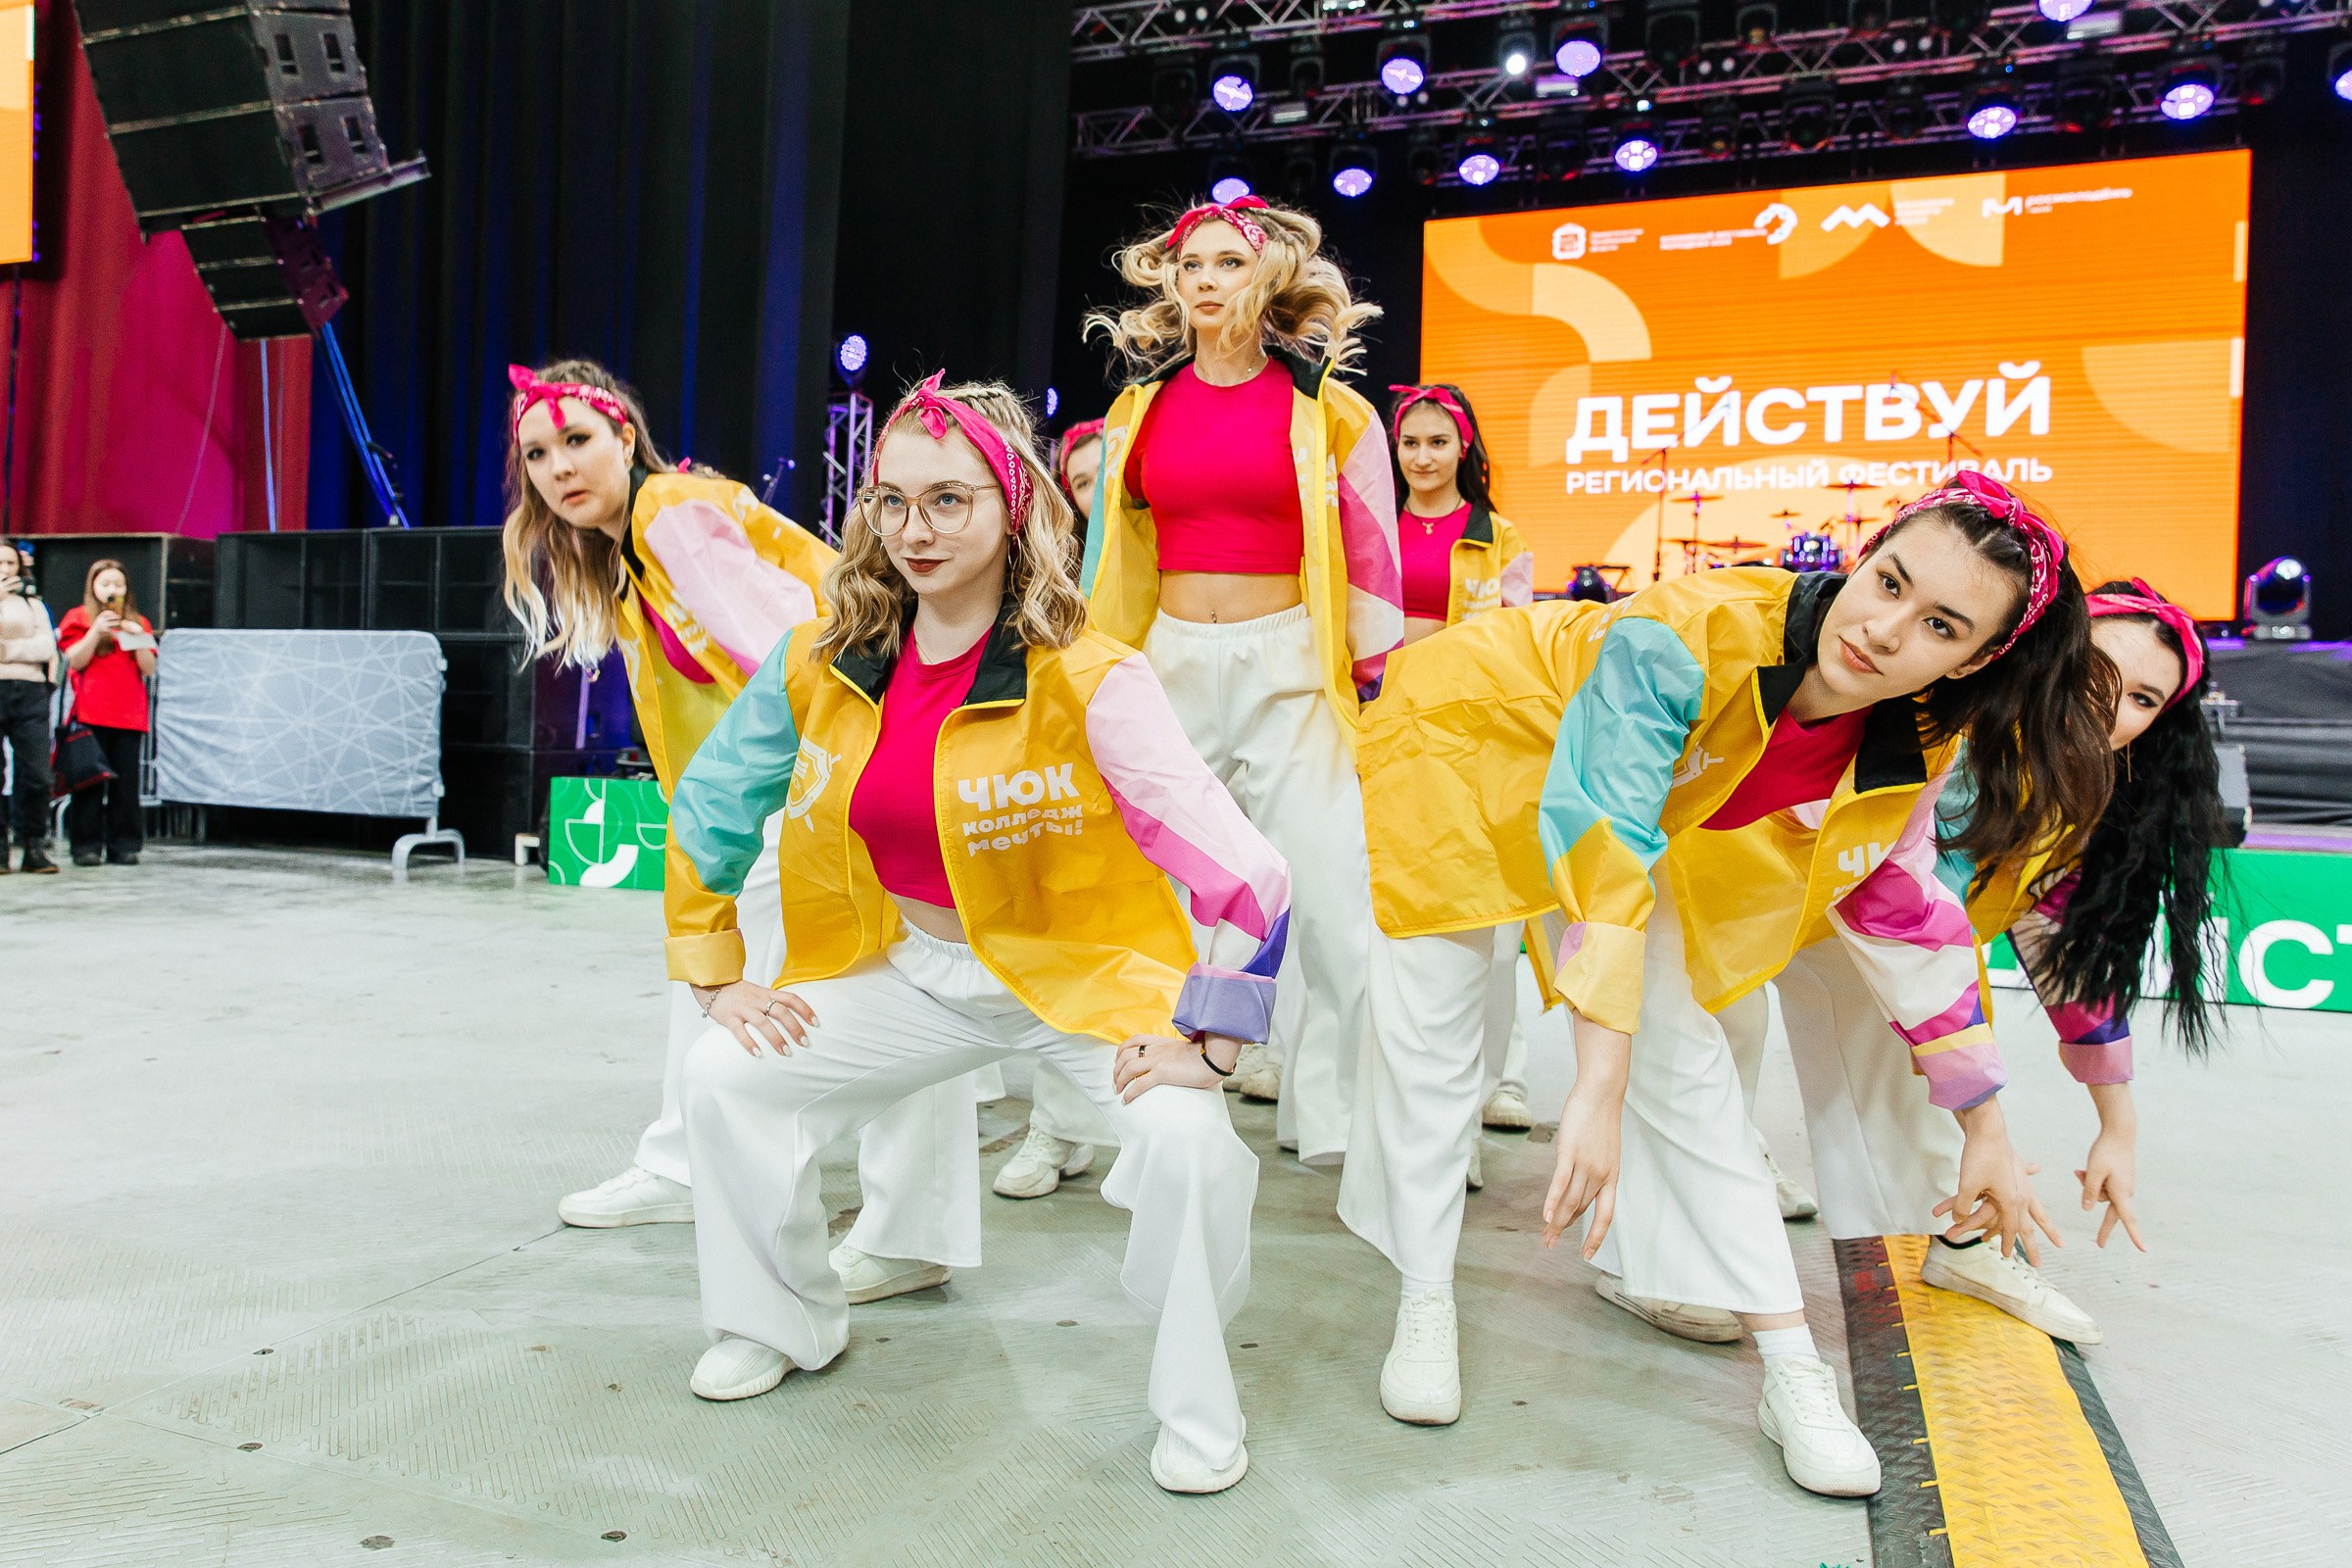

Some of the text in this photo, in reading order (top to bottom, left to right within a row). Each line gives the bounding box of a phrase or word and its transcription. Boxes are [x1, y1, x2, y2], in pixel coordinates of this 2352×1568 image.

[1565, 361, 2051, 465] ДЕЙСТВУЙ
[1566, 458, 1830, 495] РЕГИОНАЛЬНЫЙ
[957, 762, 1080, 812] ЧЮК
[961, 805, 1084, 836] колледж
[966, 819, 1084, 858] мечты!
